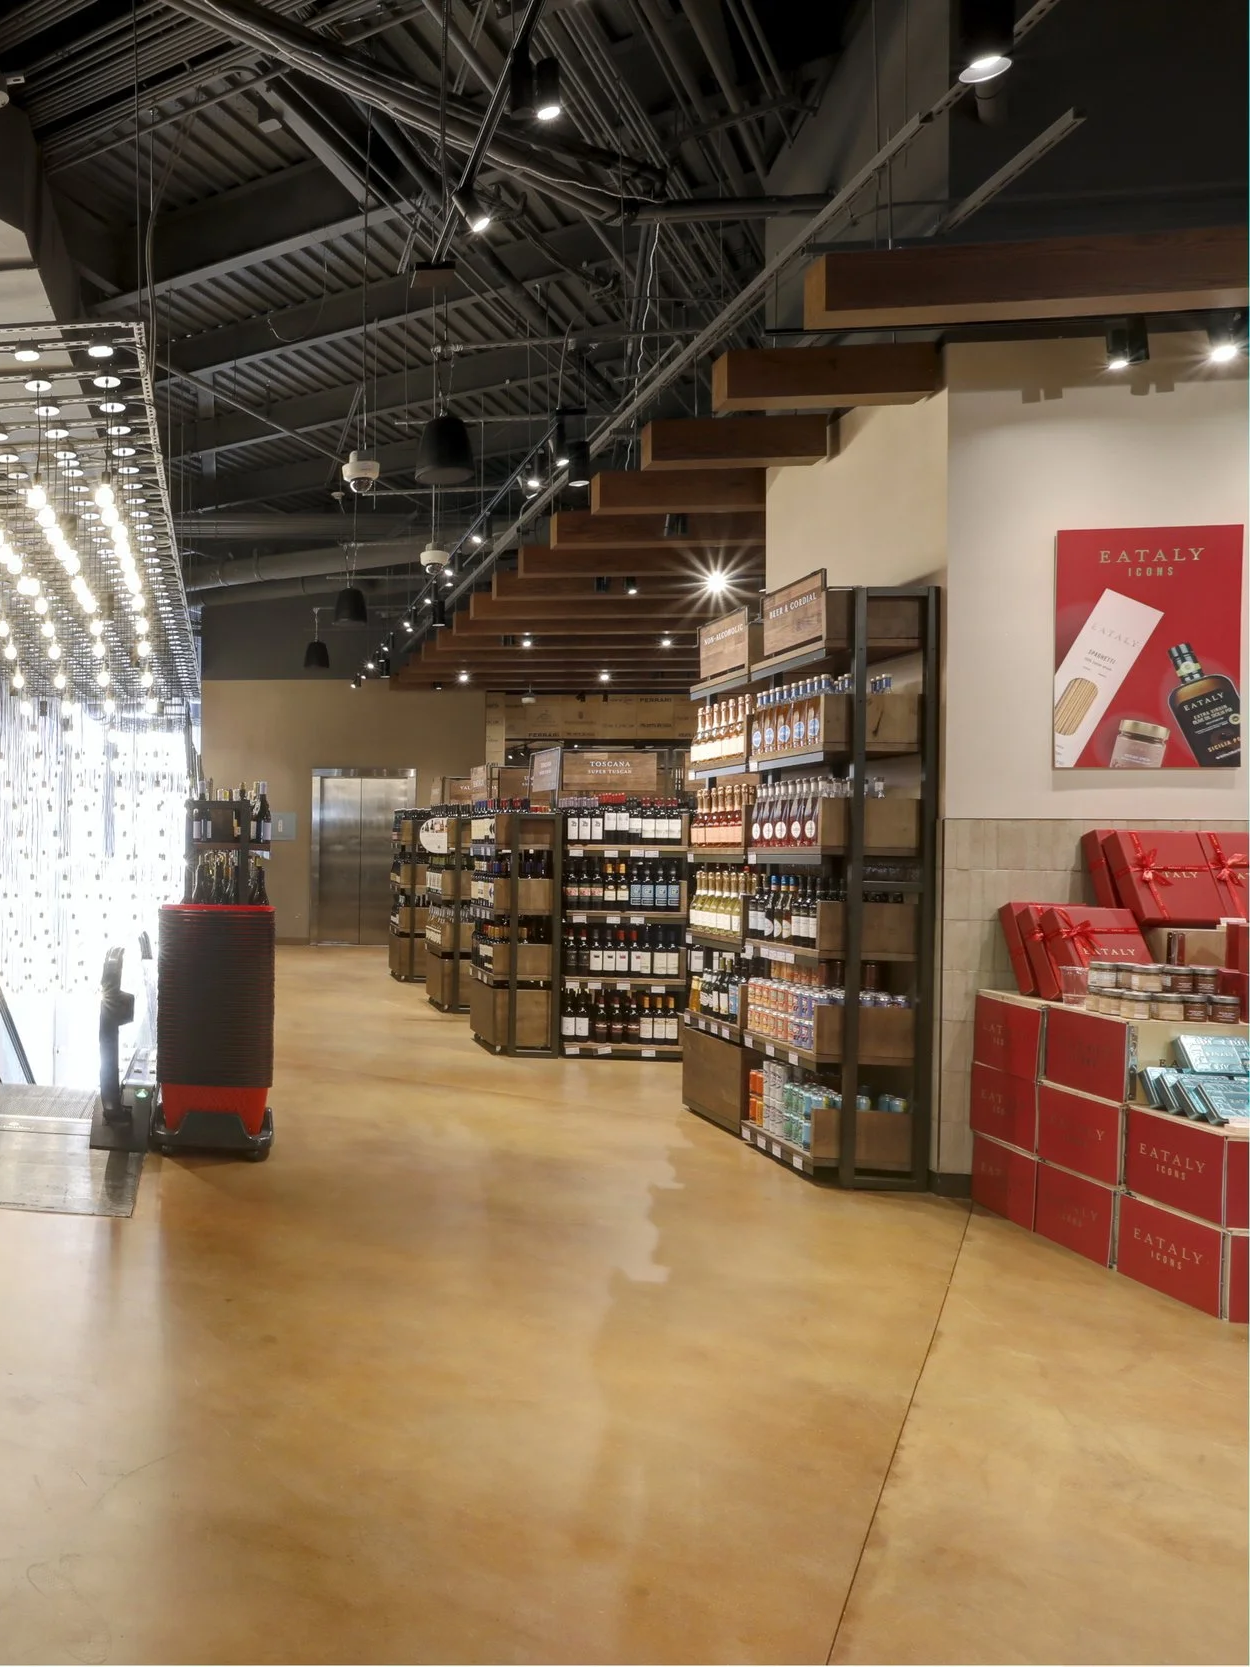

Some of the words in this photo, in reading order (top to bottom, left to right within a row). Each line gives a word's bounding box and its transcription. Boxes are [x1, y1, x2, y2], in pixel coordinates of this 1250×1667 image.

[1099, 547, 1205, 564] EATALY
[1128, 566, 1174, 577] ICONS
[769, 607, 784, 620] BEER
[790, 592, 817, 610] CORDIAL
[704, 623, 744, 645] NON-ALCOHOLIC
[1091, 622, 1140, 648] EATALY
[1183, 692, 1224, 711] EATALY
[1207, 740, 1232, 752] SICILIA
[1162, 871, 1197, 879] TALY
[1139, 1142, 1206, 1173] EATALY
[1156, 1163, 1186, 1181] ICONS
[1134, 1227, 1204, 1265] EATALY
[1150, 1250, 1182, 1270] ICONS
